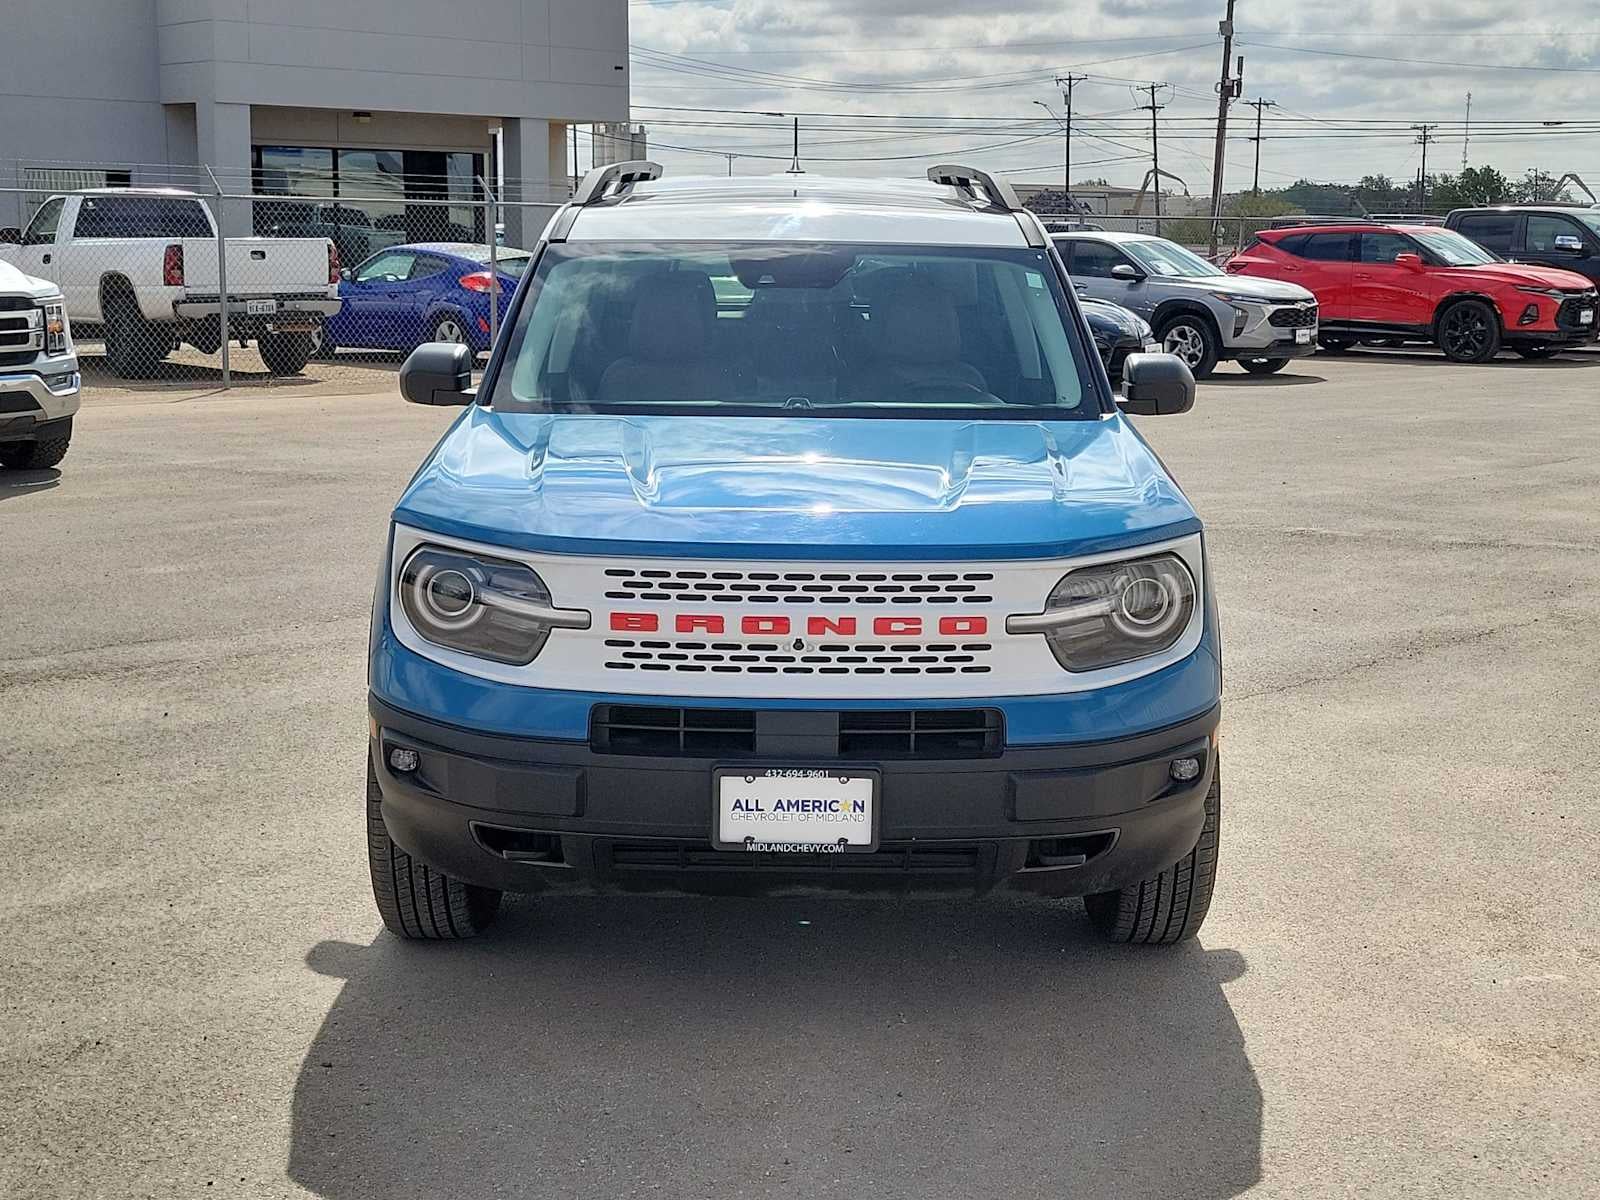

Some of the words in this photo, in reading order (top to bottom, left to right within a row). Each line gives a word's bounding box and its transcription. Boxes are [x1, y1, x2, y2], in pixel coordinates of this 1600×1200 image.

[610, 612, 988, 636] BRONCO
[765, 769, 830, 778] 432-694-9601
[731, 799, 764, 812] ALL
[730, 813, 796, 822] CHEVROLET
[798, 813, 814, 822] OF
[816, 813, 865, 823] MIDLAND
[746, 843, 845, 853] MIDLANDCHEVY.COM
